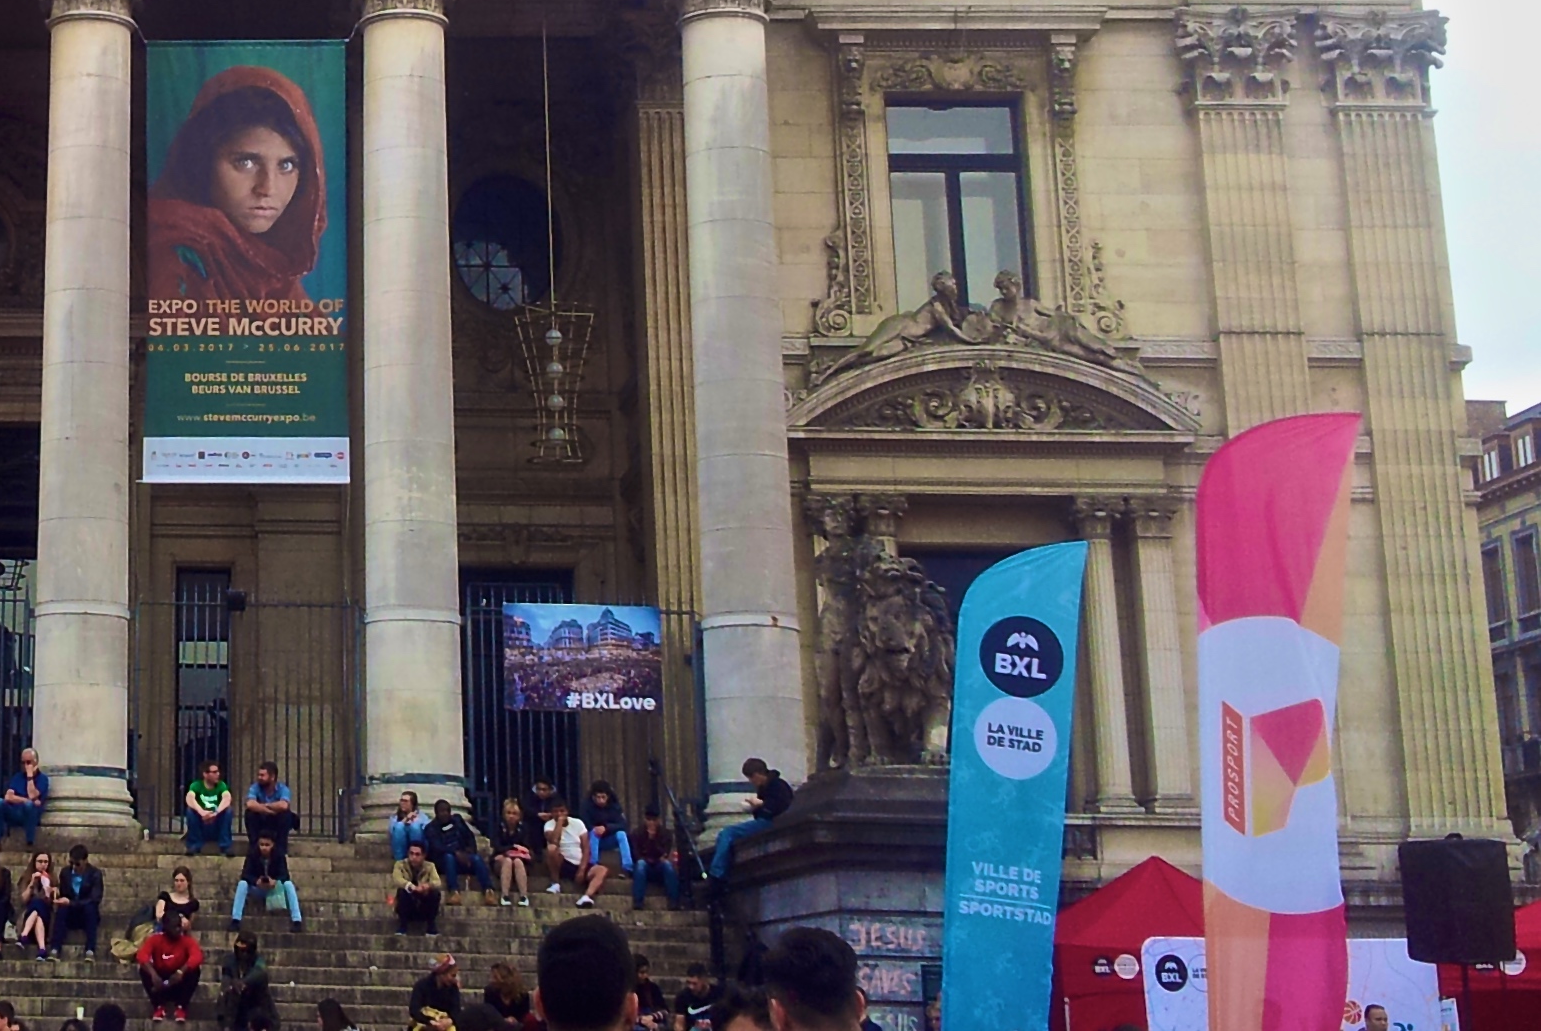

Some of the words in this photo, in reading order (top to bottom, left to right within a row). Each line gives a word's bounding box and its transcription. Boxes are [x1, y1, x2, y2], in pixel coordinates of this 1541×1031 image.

[148, 299, 198, 314] EXPO
[206, 299, 241, 314] THE
[245, 299, 313, 314] WORLD
[319, 299, 344, 313] OF
[148, 317, 220, 336] STEVE
[228, 317, 344, 336] McCURRY
[184, 373, 227, 382] BOURSE
[231, 373, 245, 382] DE
[247, 373, 307, 382] BRUXELLES
[191, 385, 226, 394] BEURS
[228, 385, 251, 394] VAN
[254, 385, 301, 394] BRUSSEL
[177, 413, 316, 424] www.stevemccurryexpo.be
[994, 652, 1047, 680] BXL
[566, 692, 656, 711] #BXLove
[987, 722, 1005, 735] LA
[1007, 725, 1044, 740] VILLE
[986, 735, 1005, 748] DE
[1007, 738, 1042, 753] STAD
[1225, 716, 1240, 822] PROSPORT
[971, 861, 1019, 880] VILLE
[1023, 868, 1042, 884] DE
[974, 879, 1039, 899] SPORTS
[958, 900, 1051, 925] SPORTSTAD
[849, 922, 926, 950] JESUS
[1161, 972, 1183, 983] BXL
